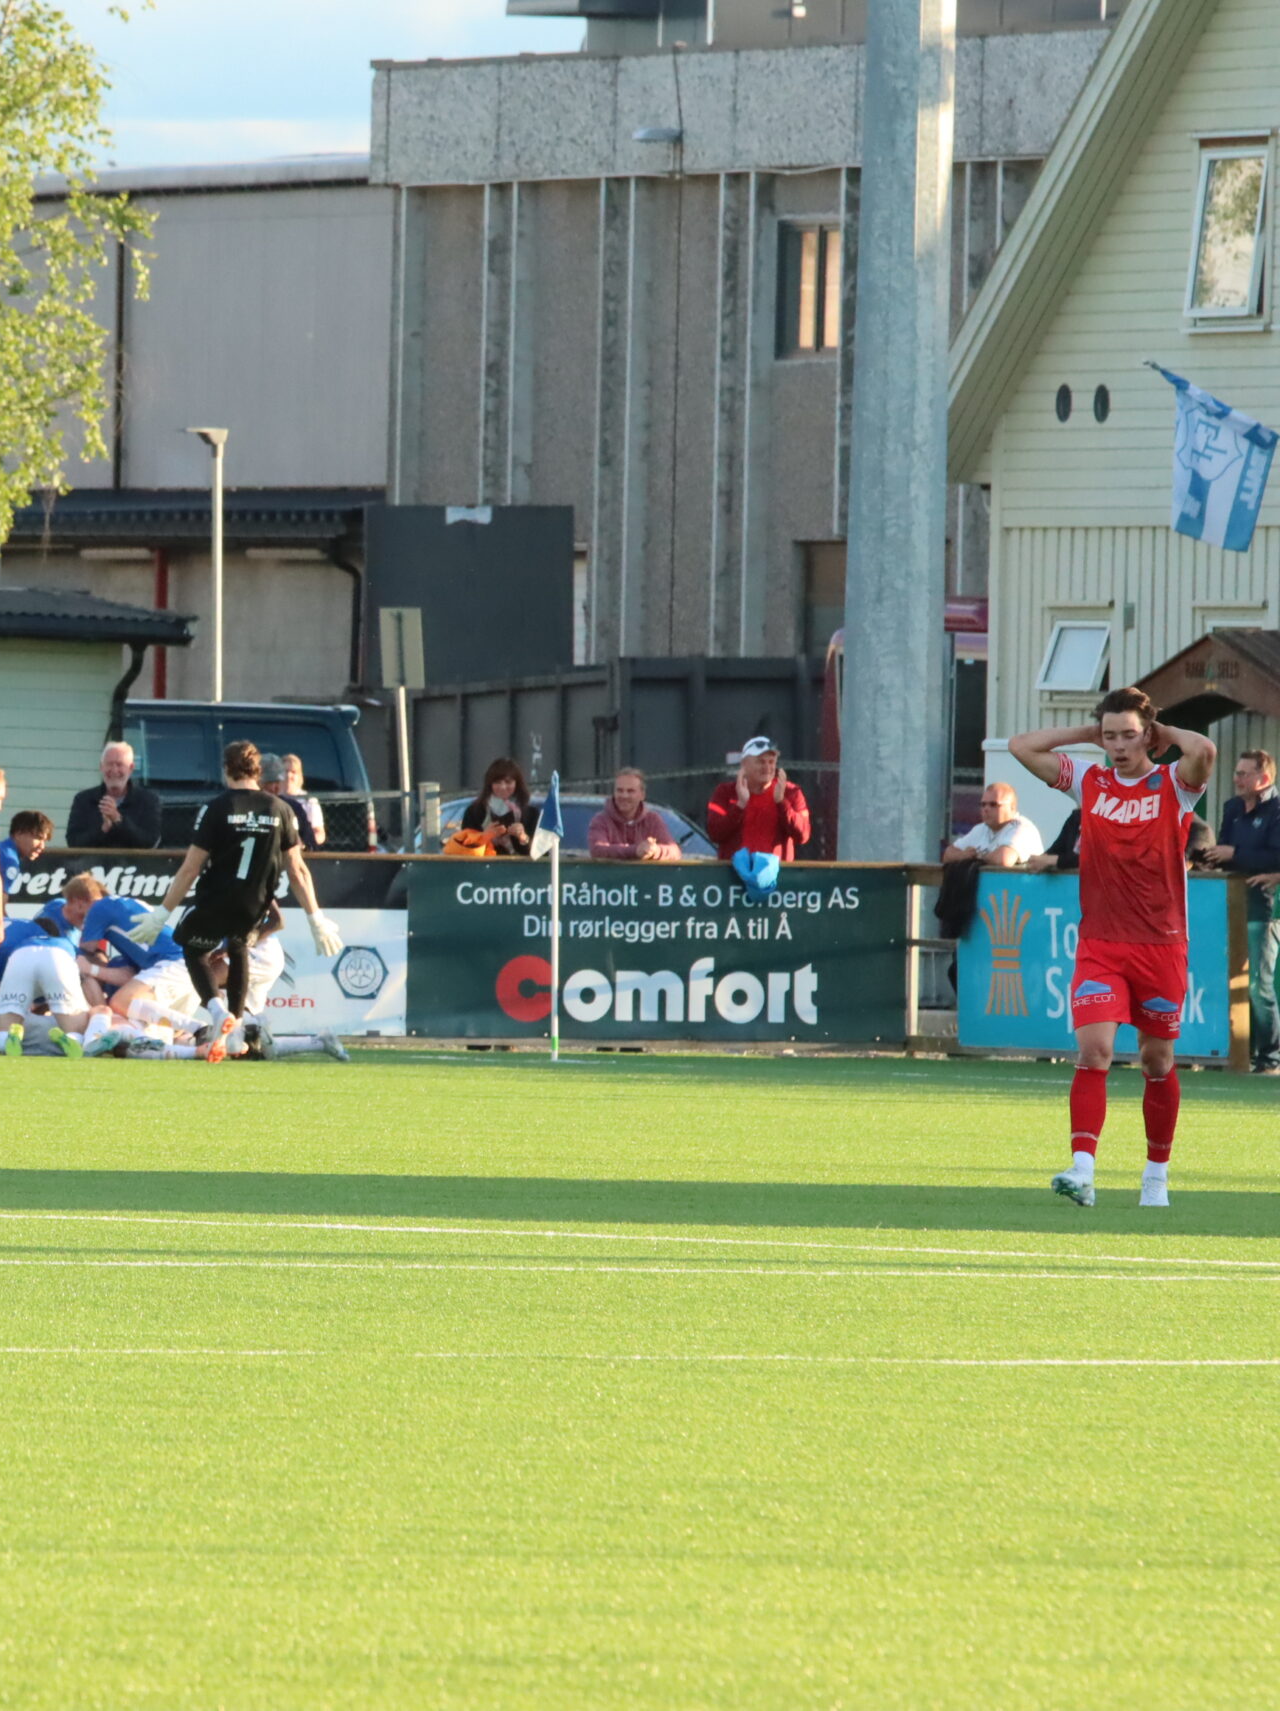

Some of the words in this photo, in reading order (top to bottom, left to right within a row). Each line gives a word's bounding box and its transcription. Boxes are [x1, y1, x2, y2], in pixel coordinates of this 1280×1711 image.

[1090, 792, 1161, 824] MAPEI
[236, 836, 256, 880] 1
[456, 881, 555, 906] Comfort
[562, 881, 639, 907] Råholt
[658, 884, 674, 908] B
[679, 884, 697, 908] &
[703, 884, 723, 908] O
[827, 886, 860, 910] AS
[569, 915, 681, 944] rørlegger
[685, 917, 719, 940] fra
[747, 917, 769, 940] til
[775, 911, 793, 940] Å
[495, 955, 818, 1025] Comfort
